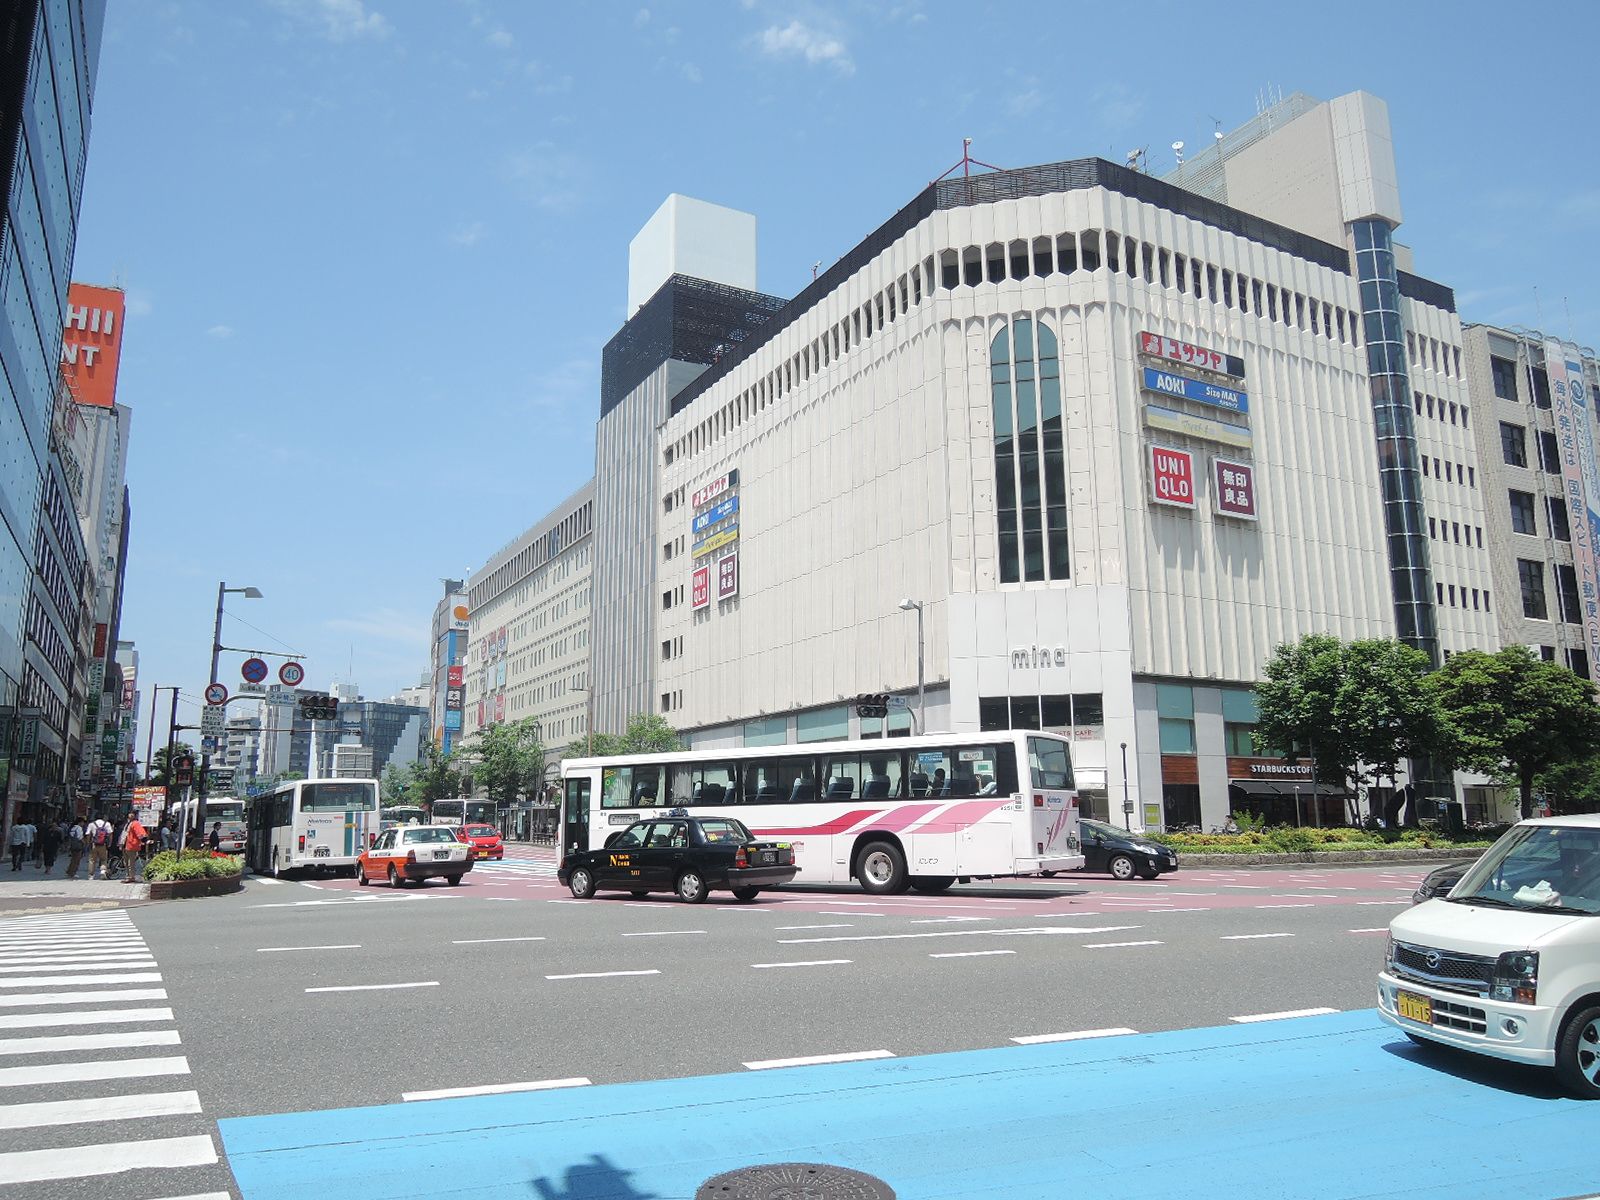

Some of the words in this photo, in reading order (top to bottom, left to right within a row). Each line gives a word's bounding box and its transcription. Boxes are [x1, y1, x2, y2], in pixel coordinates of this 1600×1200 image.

[65, 303, 114, 335] HII
[60, 341, 101, 367] NT
[1156, 373, 1185, 395] AOKI
[1206, 386, 1221, 399] Size
[1221, 391, 1238, 403] MAX
[1157, 454, 1185, 477] UNI
[1159, 476, 1189, 498] QLO
[1222, 469, 1247, 488] 無印
[1225, 488, 1249, 507] 良品
[721, 561, 734, 576] 無印
[693, 573, 706, 588] UNI
[721, 575, 734, 590] 良品
[693, 588, 706, 604] QLO
[1011, 645, 1066, 669] mina
[284, 668, 299, 680] 40
[1250, 764, 1296, 774] STARBUCKS
[1296, 765, 1314, 774] COF
